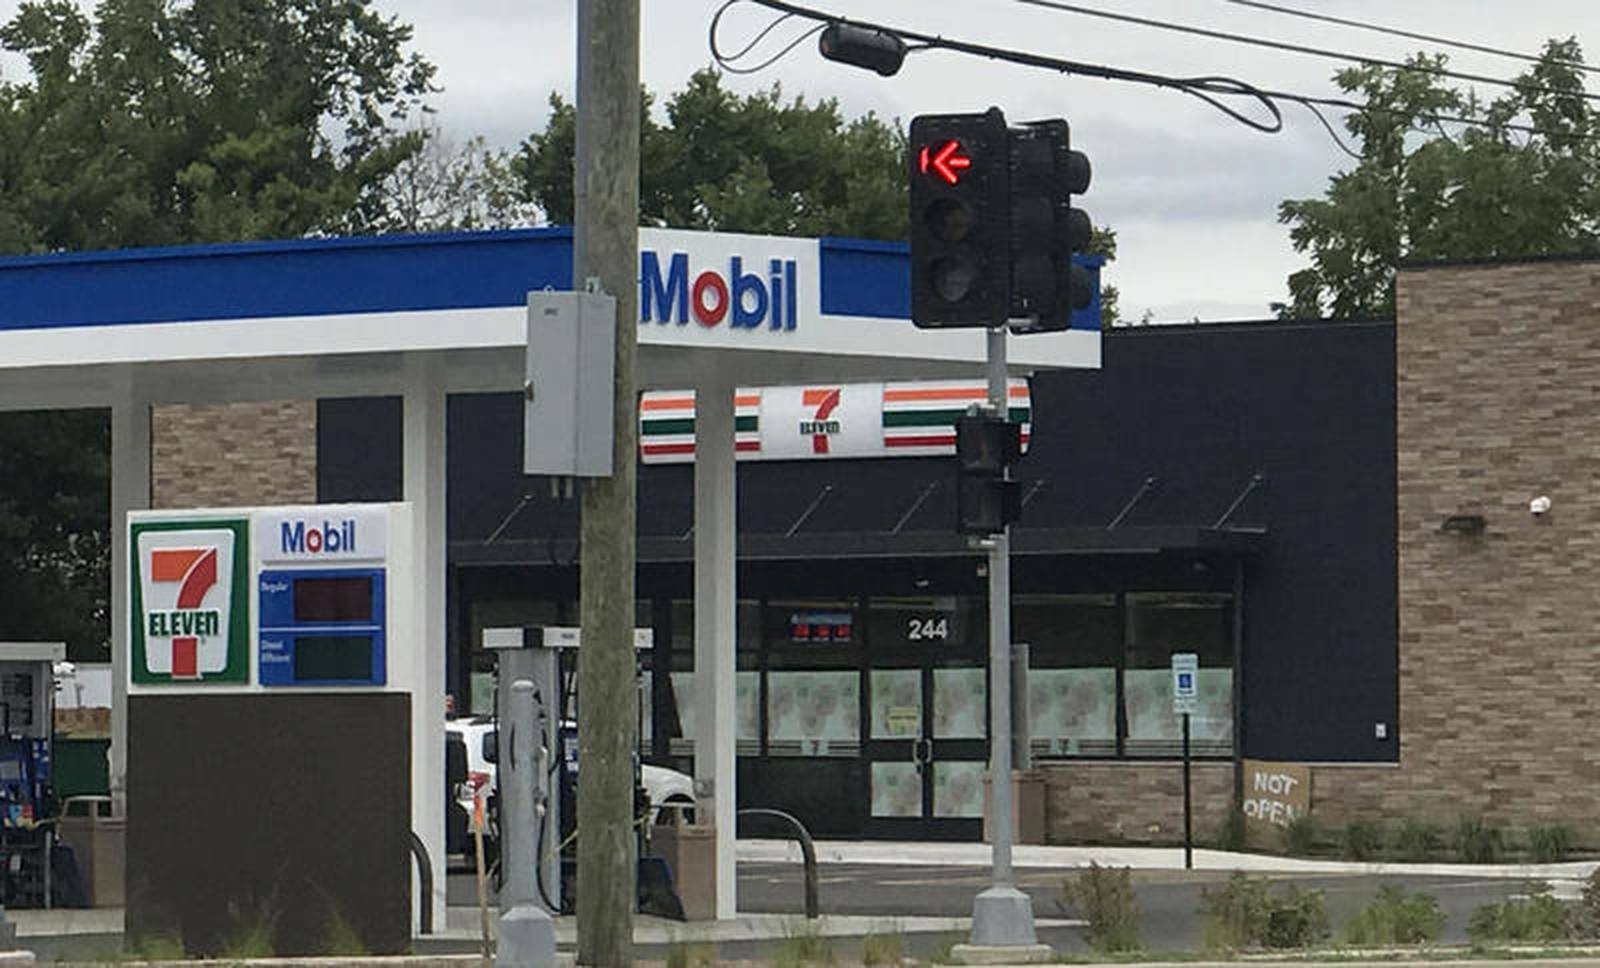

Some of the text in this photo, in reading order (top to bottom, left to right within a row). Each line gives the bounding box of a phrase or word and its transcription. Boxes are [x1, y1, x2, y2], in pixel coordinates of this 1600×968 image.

[641, 250, 797, 330] Mobil
[803, 389, 841, 453] 7
[281, 520, 355, 553] Mobil
[152, 548, 217, 676] 7
[908, 619, 948, 640] 244
[1254, 772, 1298, 795] NOT
